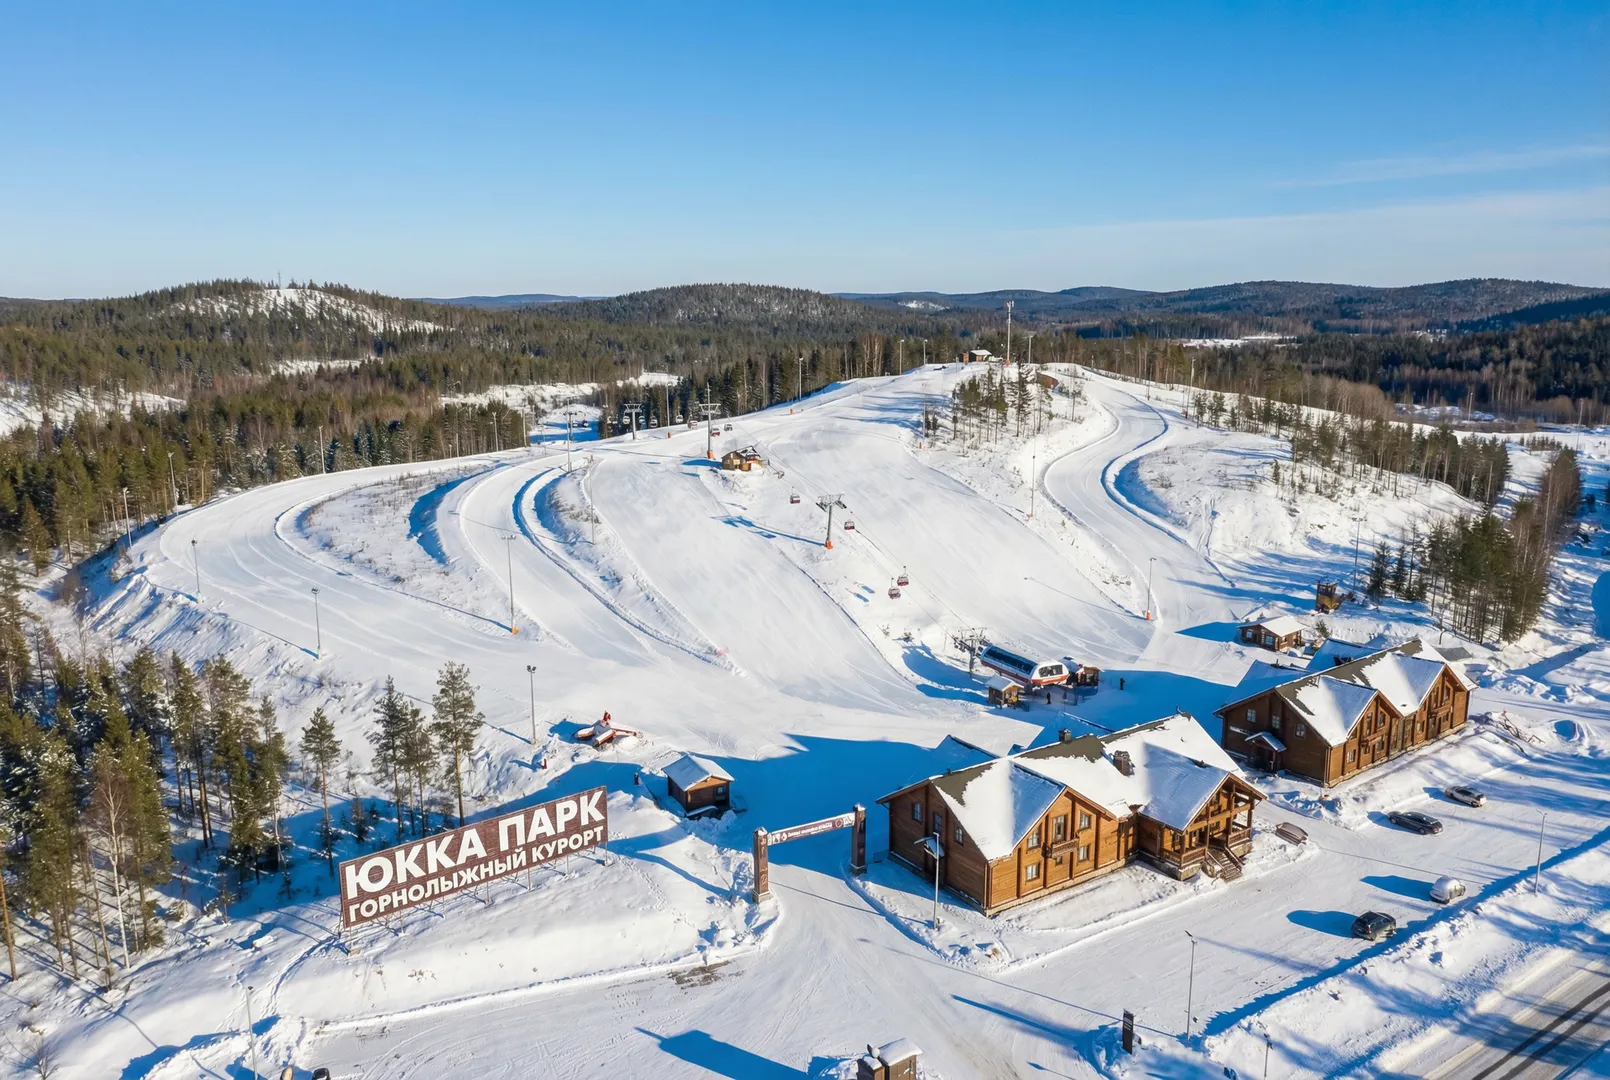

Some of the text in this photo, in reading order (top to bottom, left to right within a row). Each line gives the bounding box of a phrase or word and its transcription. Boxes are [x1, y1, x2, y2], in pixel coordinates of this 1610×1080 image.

[345, 790, 606, 900] ЮККА ПАРК
[349, 825, 604, 923] ГОРНОЛЫЖНЫЙ КУРОРТ
